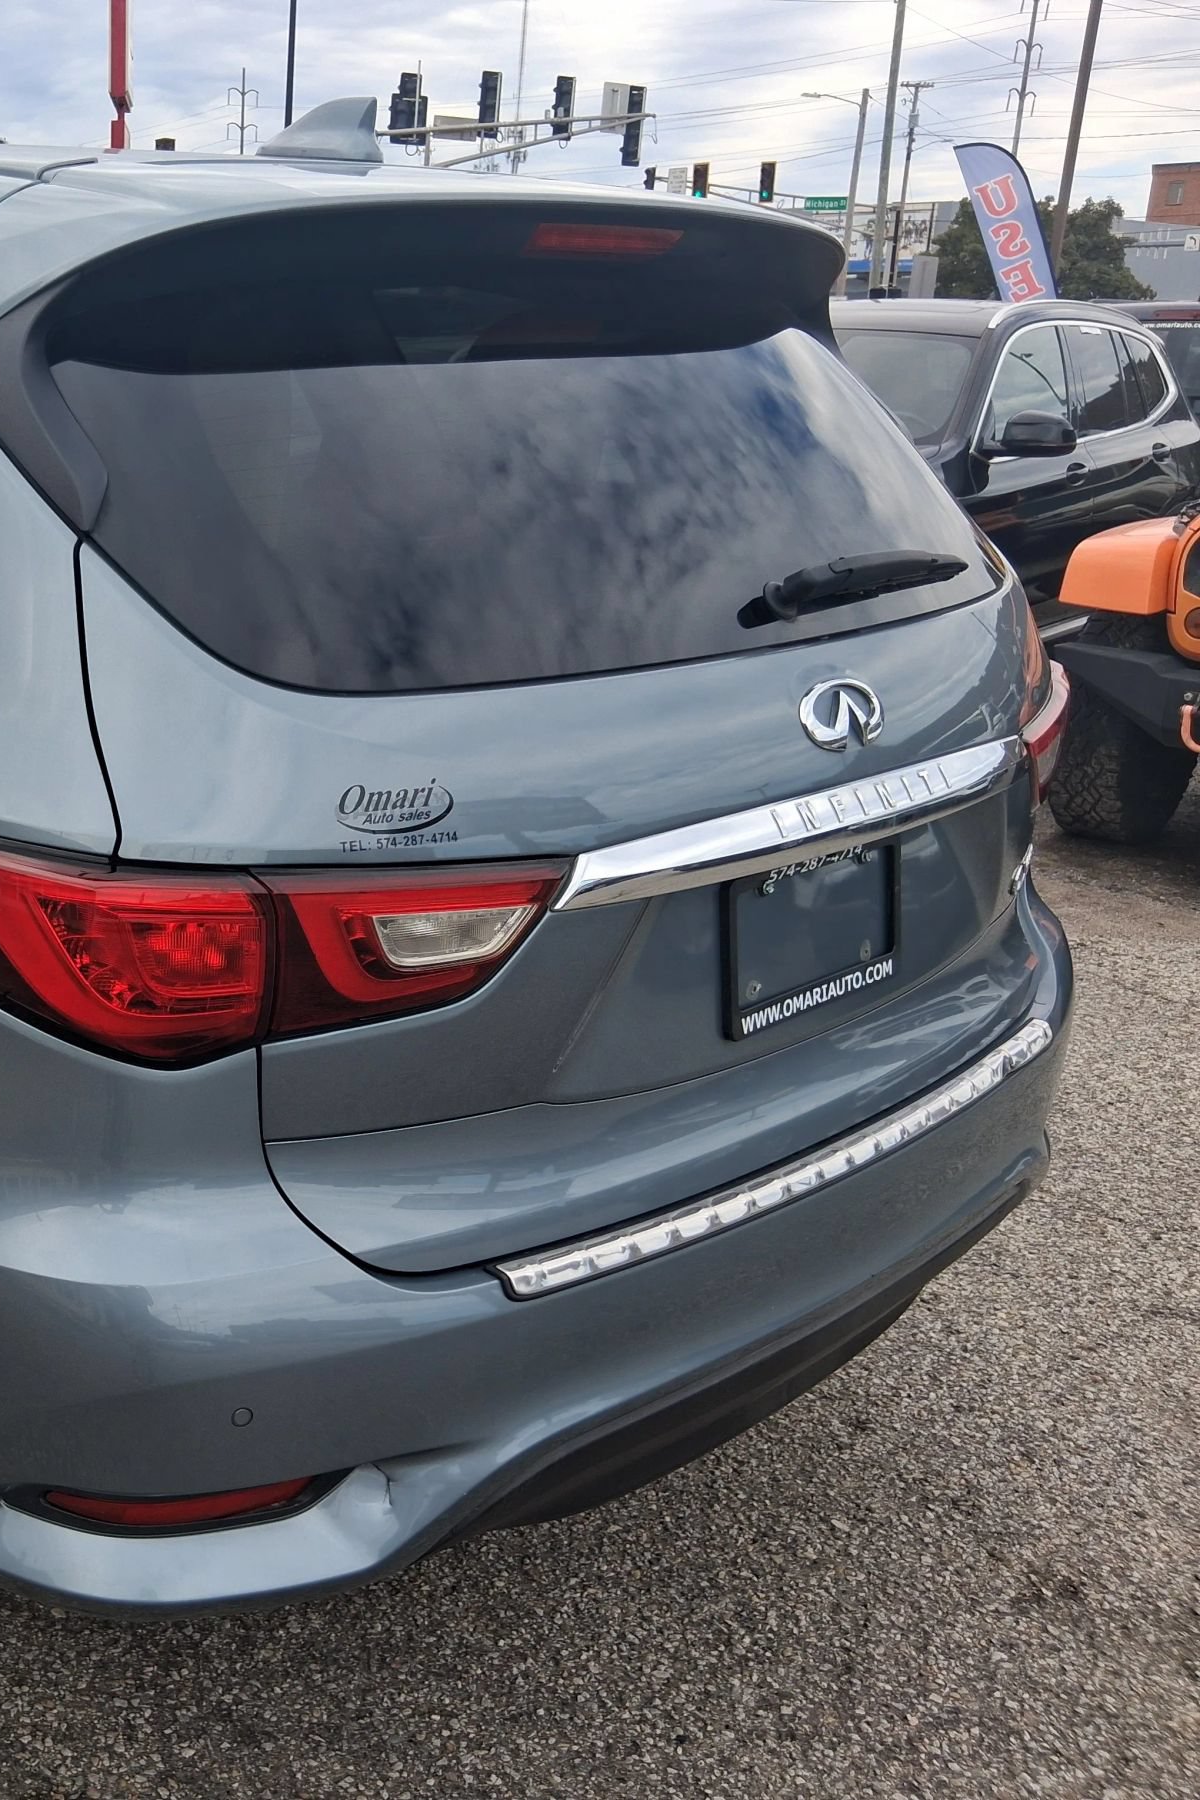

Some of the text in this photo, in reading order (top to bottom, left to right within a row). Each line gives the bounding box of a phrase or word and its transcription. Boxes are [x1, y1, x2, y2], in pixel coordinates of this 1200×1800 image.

[806, 199, 838, 209] Michigan
[338, 778, 437, 815] Omari
[769, 763, 952, 838] INFINITI
[362, 809, 431, 825] Auto sales
[340, 831, 458, 853] TEL: 574-287-4714
[741, 959, 893, 1035] WWW.OMARIAUTO.COM
